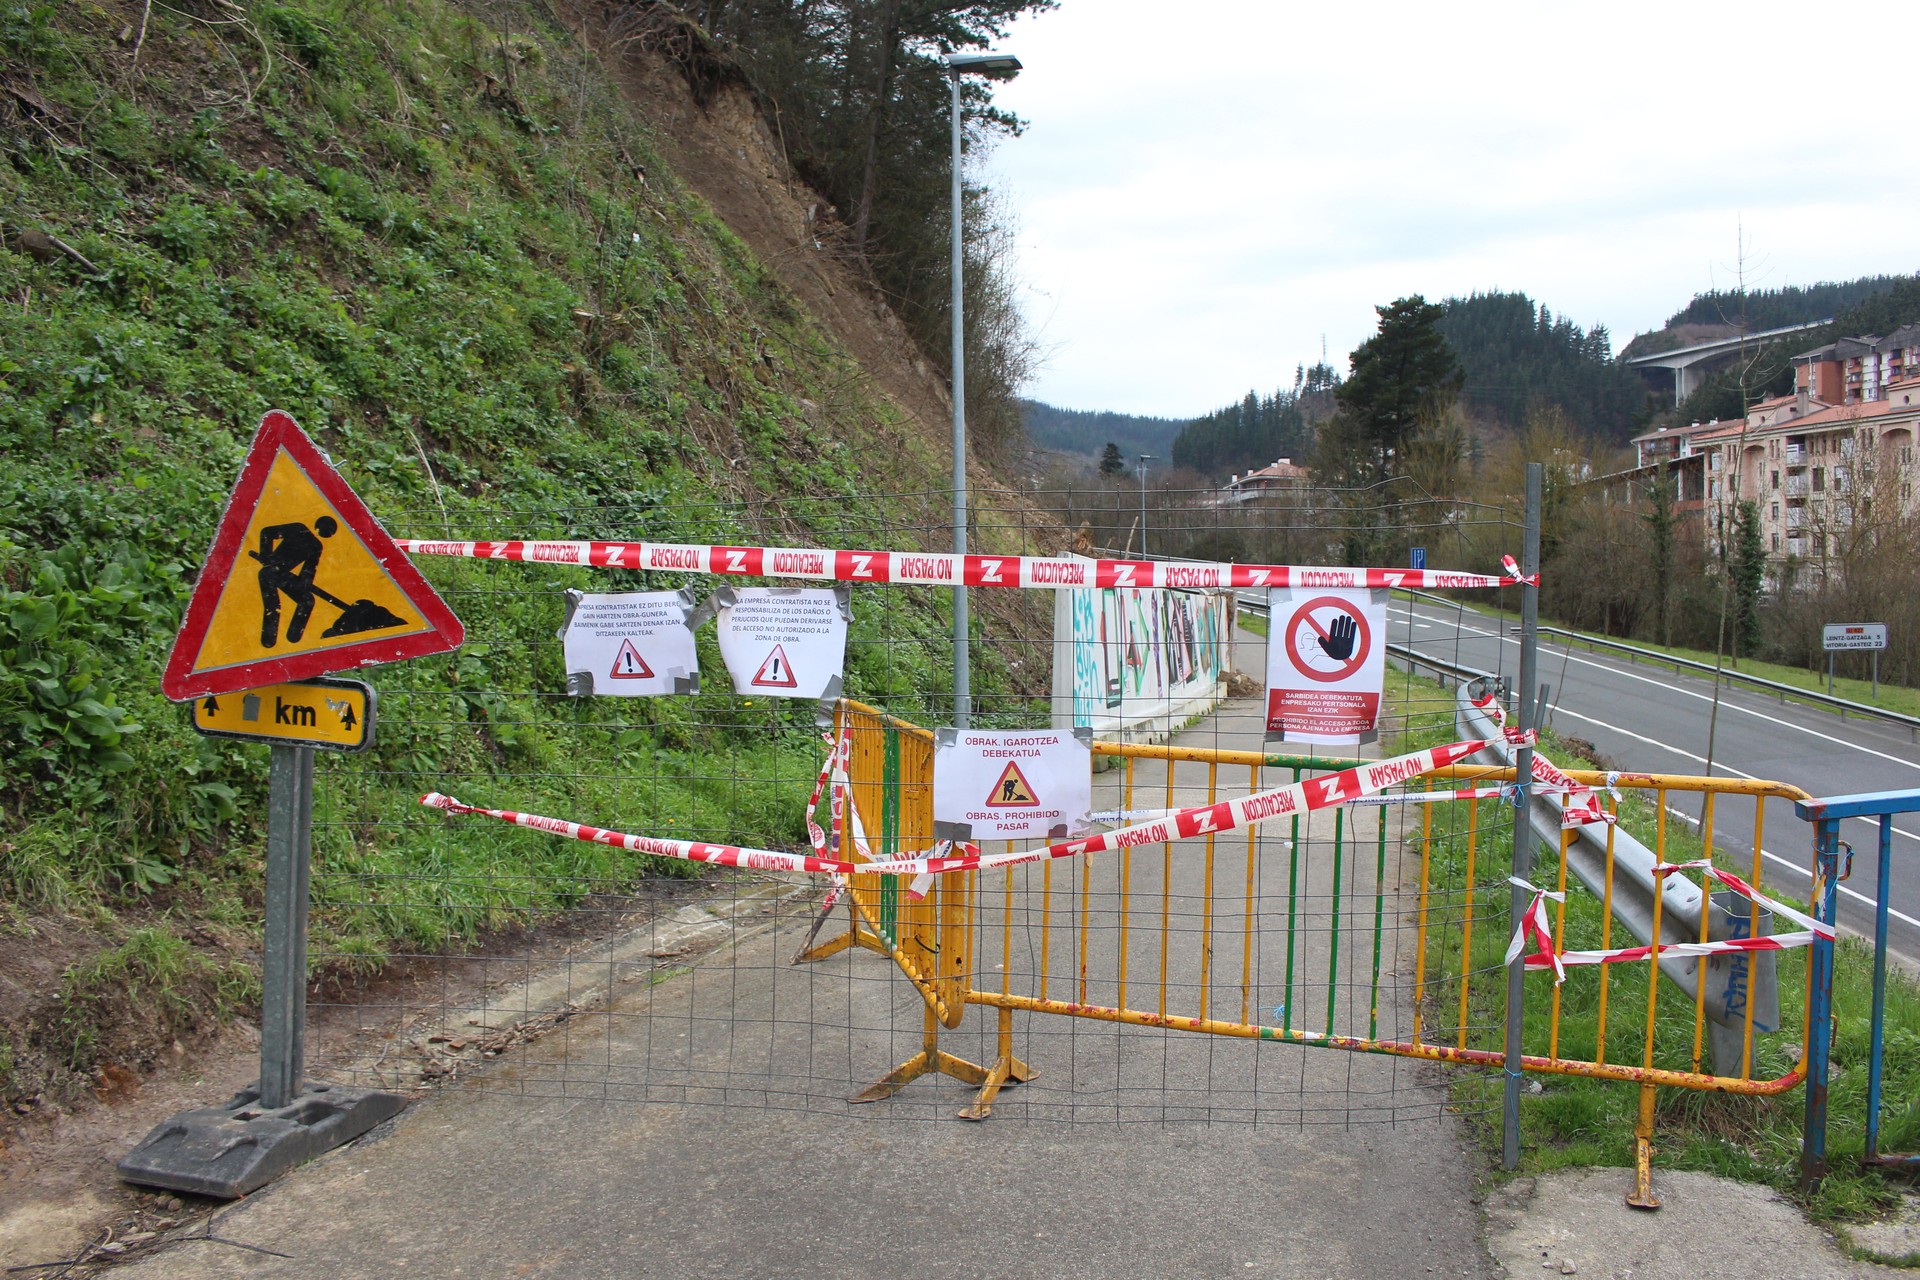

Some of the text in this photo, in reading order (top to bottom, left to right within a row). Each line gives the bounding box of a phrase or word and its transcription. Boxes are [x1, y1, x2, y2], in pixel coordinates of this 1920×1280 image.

[533, 544, 580, 562] PRECAUCION
[651, 548, 699, 569] NO PASAR
[774, 553, 823, 574] PRECAUCION
[901, 558, 952, 579] NO PASAR
[1032, 562, 1085, 584] PRECAUCION
[1166, 567, 1219, 587] NO PASAR
[1301, 571, 1354, 587] PRECAUCION
[276, 696, 316, 726] km
[965, 736, 1059, 746] OBRAK. IGAROTZEA
[982, 749, 1041, 757] DEBEKATUA
[1369, 757, 1422, 787] NO PASAR
[1532, 756, 1562, 784] PASA
[966, 810, 1059, 820] OBRAS. PROHIBIDO
[1242, 790, 1296, 822] PRECAUCION
[997, 823, 1029, 831] PASAR
[1116, 823, 1168, 848] NO PASAR
